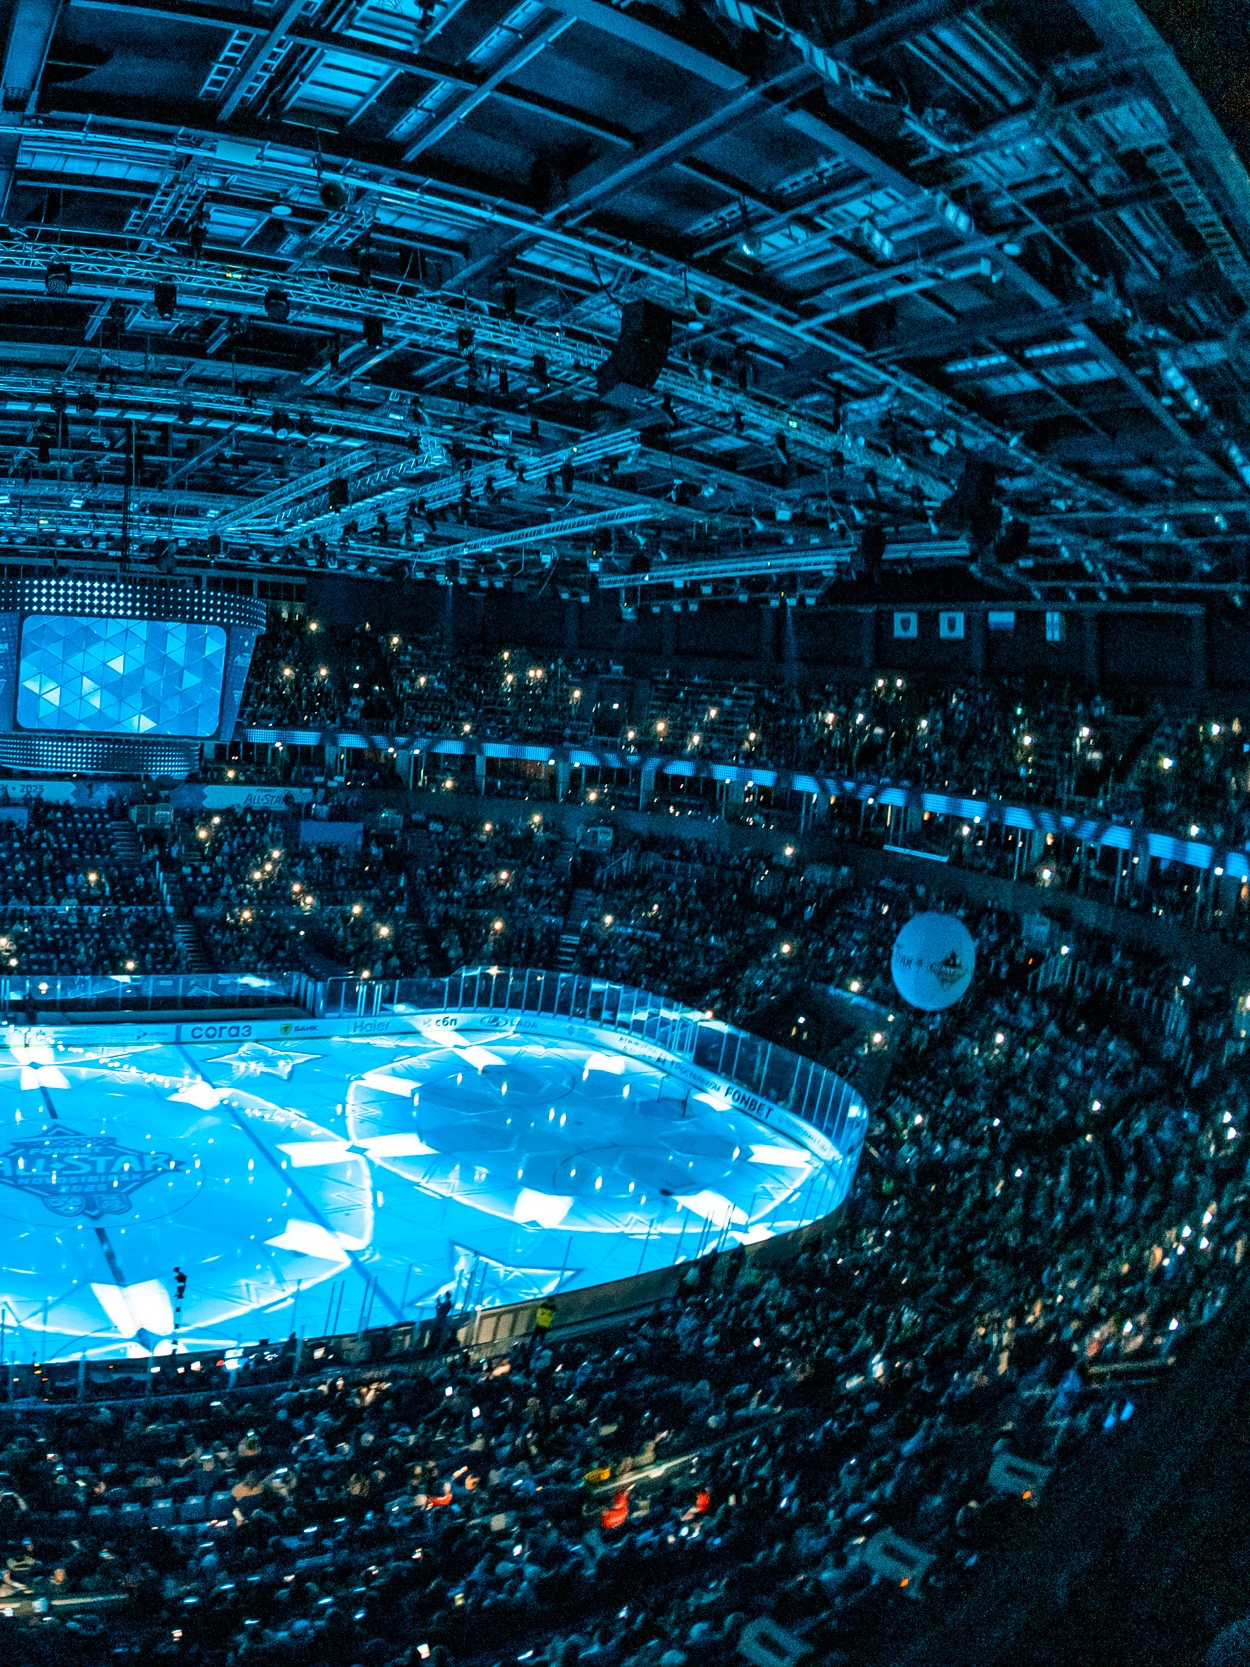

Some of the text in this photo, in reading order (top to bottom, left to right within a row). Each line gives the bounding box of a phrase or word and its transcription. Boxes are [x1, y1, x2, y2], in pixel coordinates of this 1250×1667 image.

[19, 784, 45, 793] 2025
[352, 1020, 391, 1033] Haier
[724, 1086, 774, 1119] FONBET
[29, 1146, 104, 1155] FONBET
[17, 1174, 144, 1184] NOVOSIBIRSK
[58, 1184, 108, 1193] 2025
